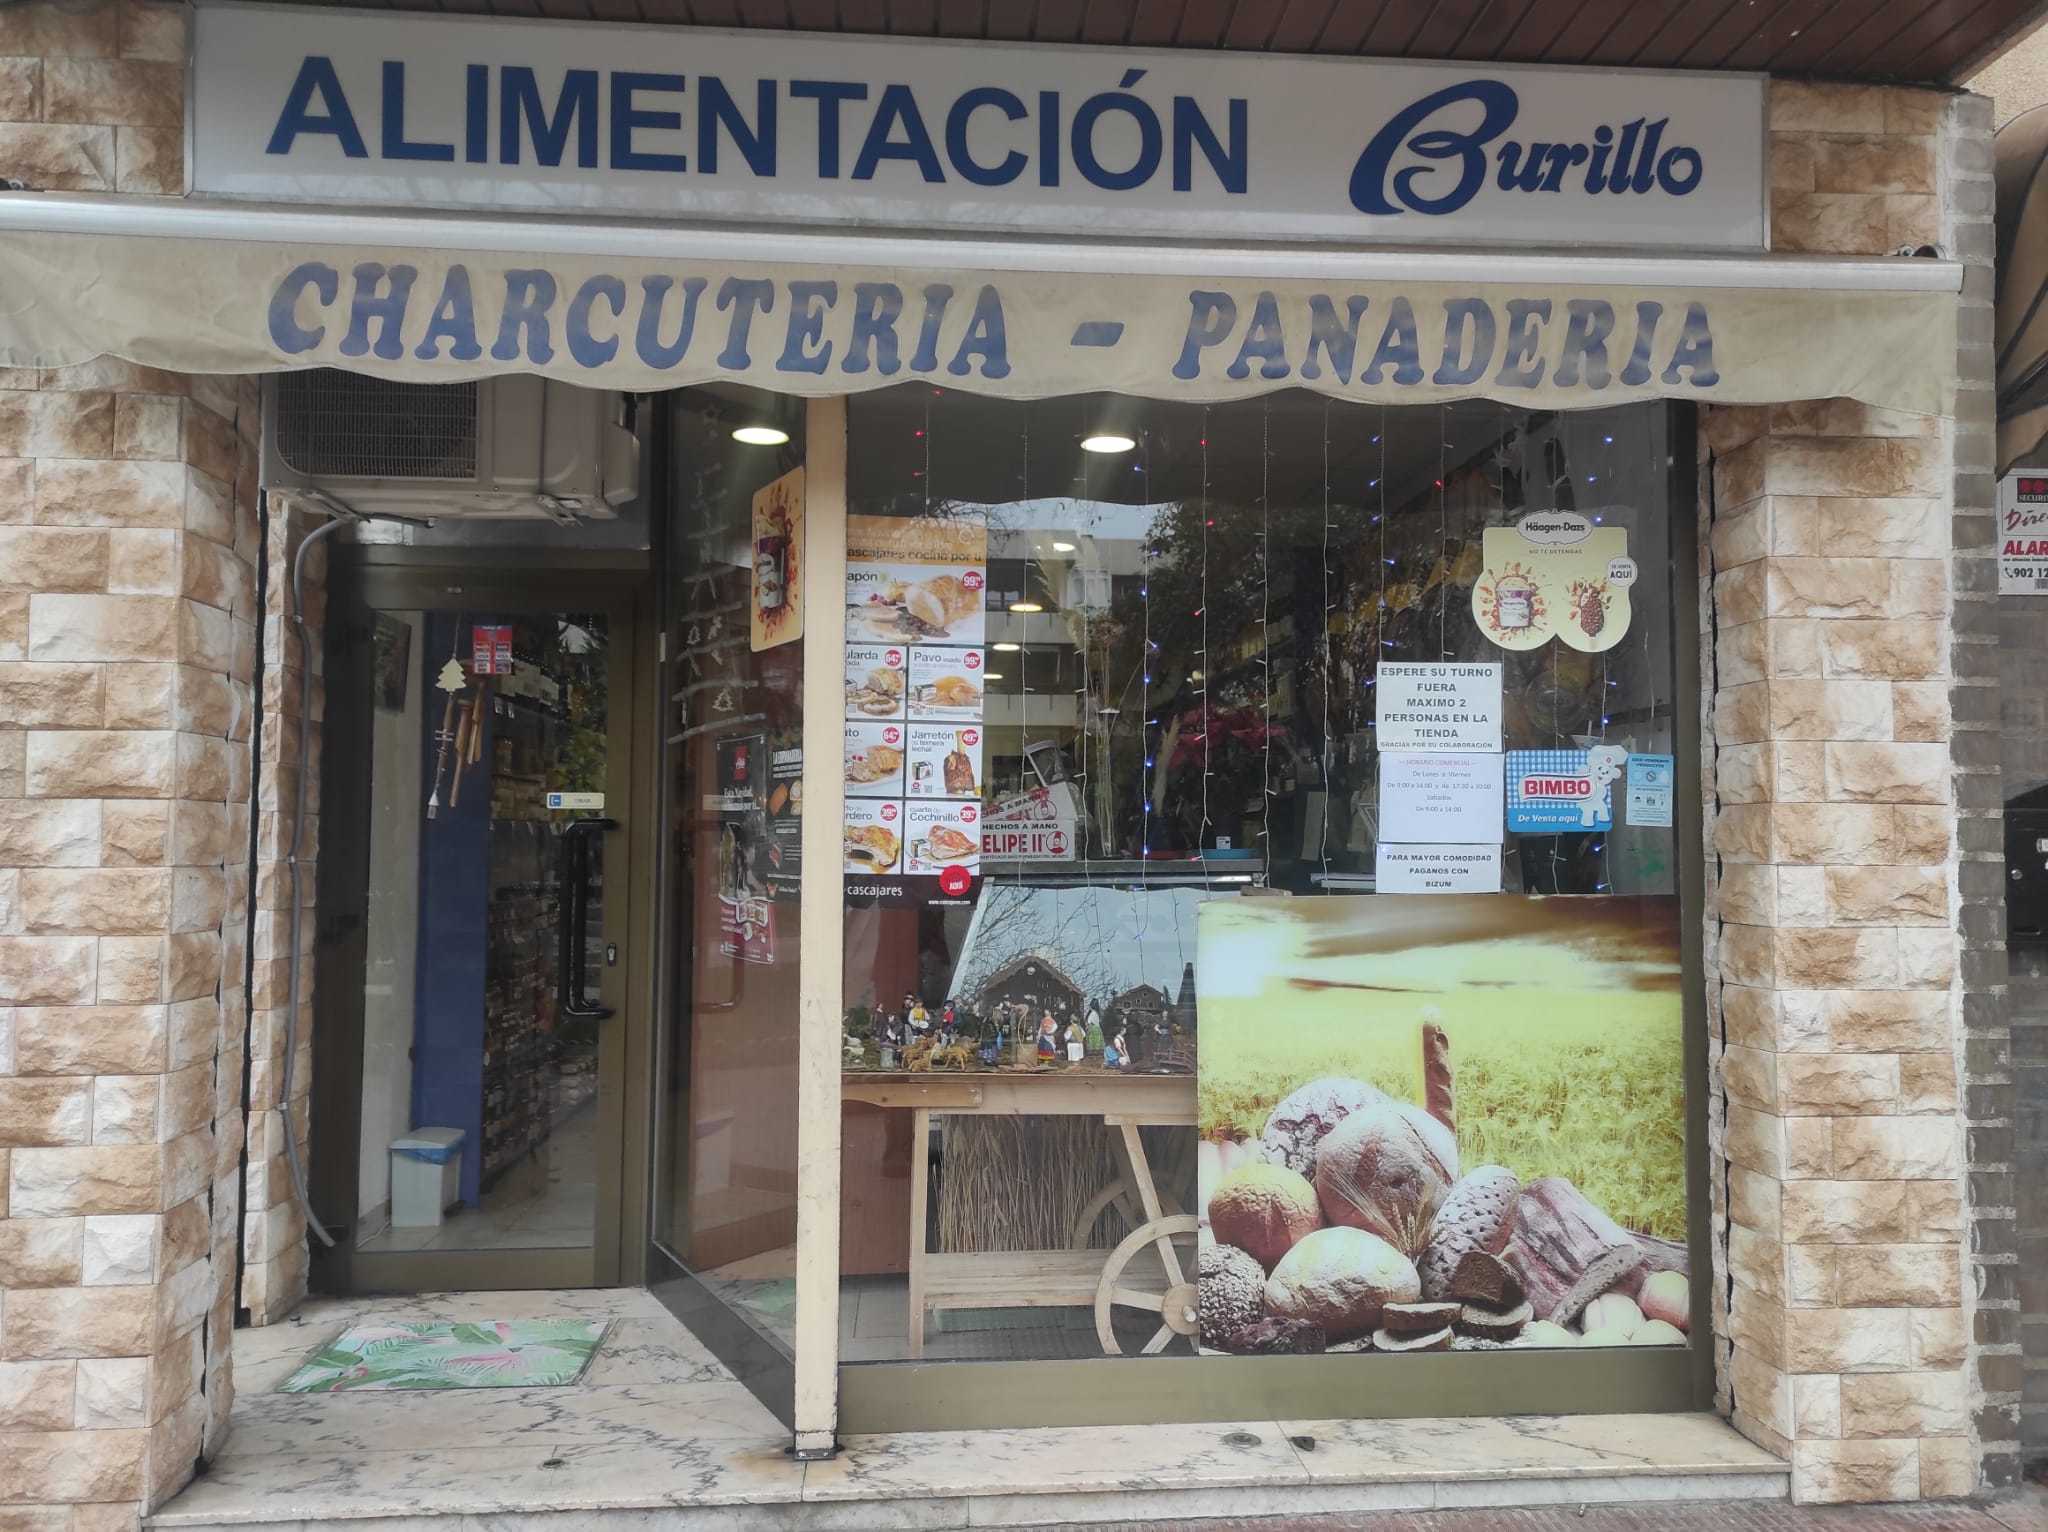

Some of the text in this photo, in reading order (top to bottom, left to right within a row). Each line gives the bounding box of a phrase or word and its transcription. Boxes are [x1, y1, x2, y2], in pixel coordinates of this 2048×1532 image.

[265, 56, 1703, 215] ALIMENTACIÓN Burillo
[268, 261, 1010, 379] CHARCUTERIA
[1172, 290, 1720, 386] PANADERIA
[1526, 522, 1585, 533] Häagen-Dazs
[847, 546, 904, 560] ascajares
[847, 571, 878, 583] apón
[2014, 567, 2033, 578] 902
[847, 649, 878, 660] larda
[914, 651, 942, 663] Pavo
[1381, 667, 1493, 677] ESPERE SU TURNO
[1417, 683, 1457, 692] FUERA
[1407, 698, 1467, 707] MAXIMO 2
[1384, 713, 1488, 723] PERSONAS EN LA
[1414, 728, 1459, 738] TIENDA
[1525, 780, 1590, 795] BIMBO
[846, 811, 872, 820] rdero
[910, 812, 960, 822] Cochinillo
[1532, 815, 1557, 823] Venta
[982, 833, 1028, 853] ELIPE
[847, 885, 903, 897] cascajares
